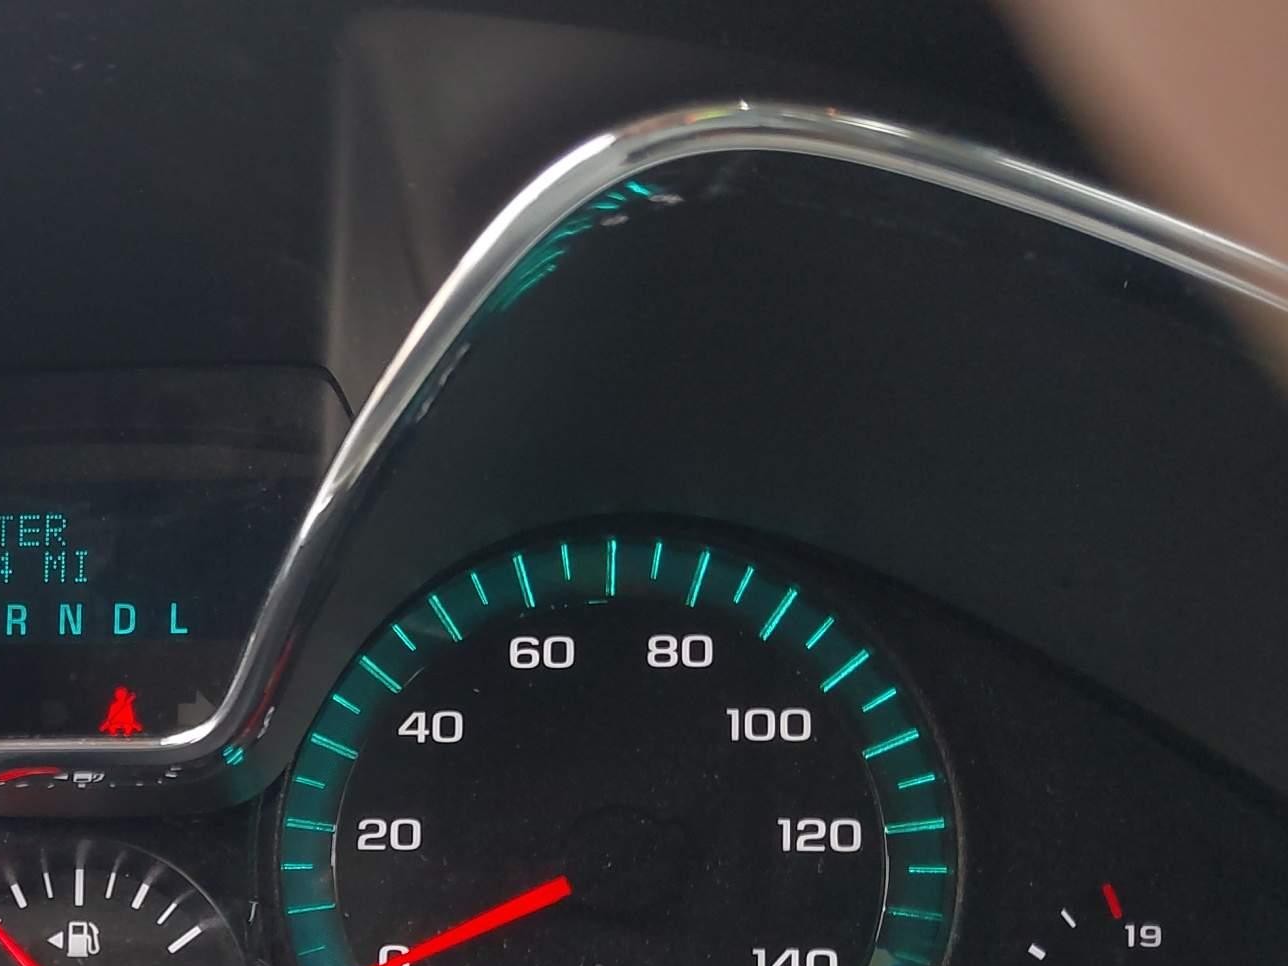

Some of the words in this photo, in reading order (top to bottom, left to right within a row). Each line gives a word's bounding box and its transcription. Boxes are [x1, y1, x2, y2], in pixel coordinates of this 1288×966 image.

[43, 550, 89, 583] MI
[5, 604, 29, 636] R
[58, 604, 83, 636] N
[113, 604, 137, 635] D
[169, 603, 189, 634] L
[509, 635, 576, 670] 60
[646, 634, 714, 669] 80
[397, 710, 465, 744] 40
[725, 707, 813, 743] 100
[356, 818, 423, 852] 20
[777, 817, 863, 854] 120
[1124, 924, 1162, 948] 19
